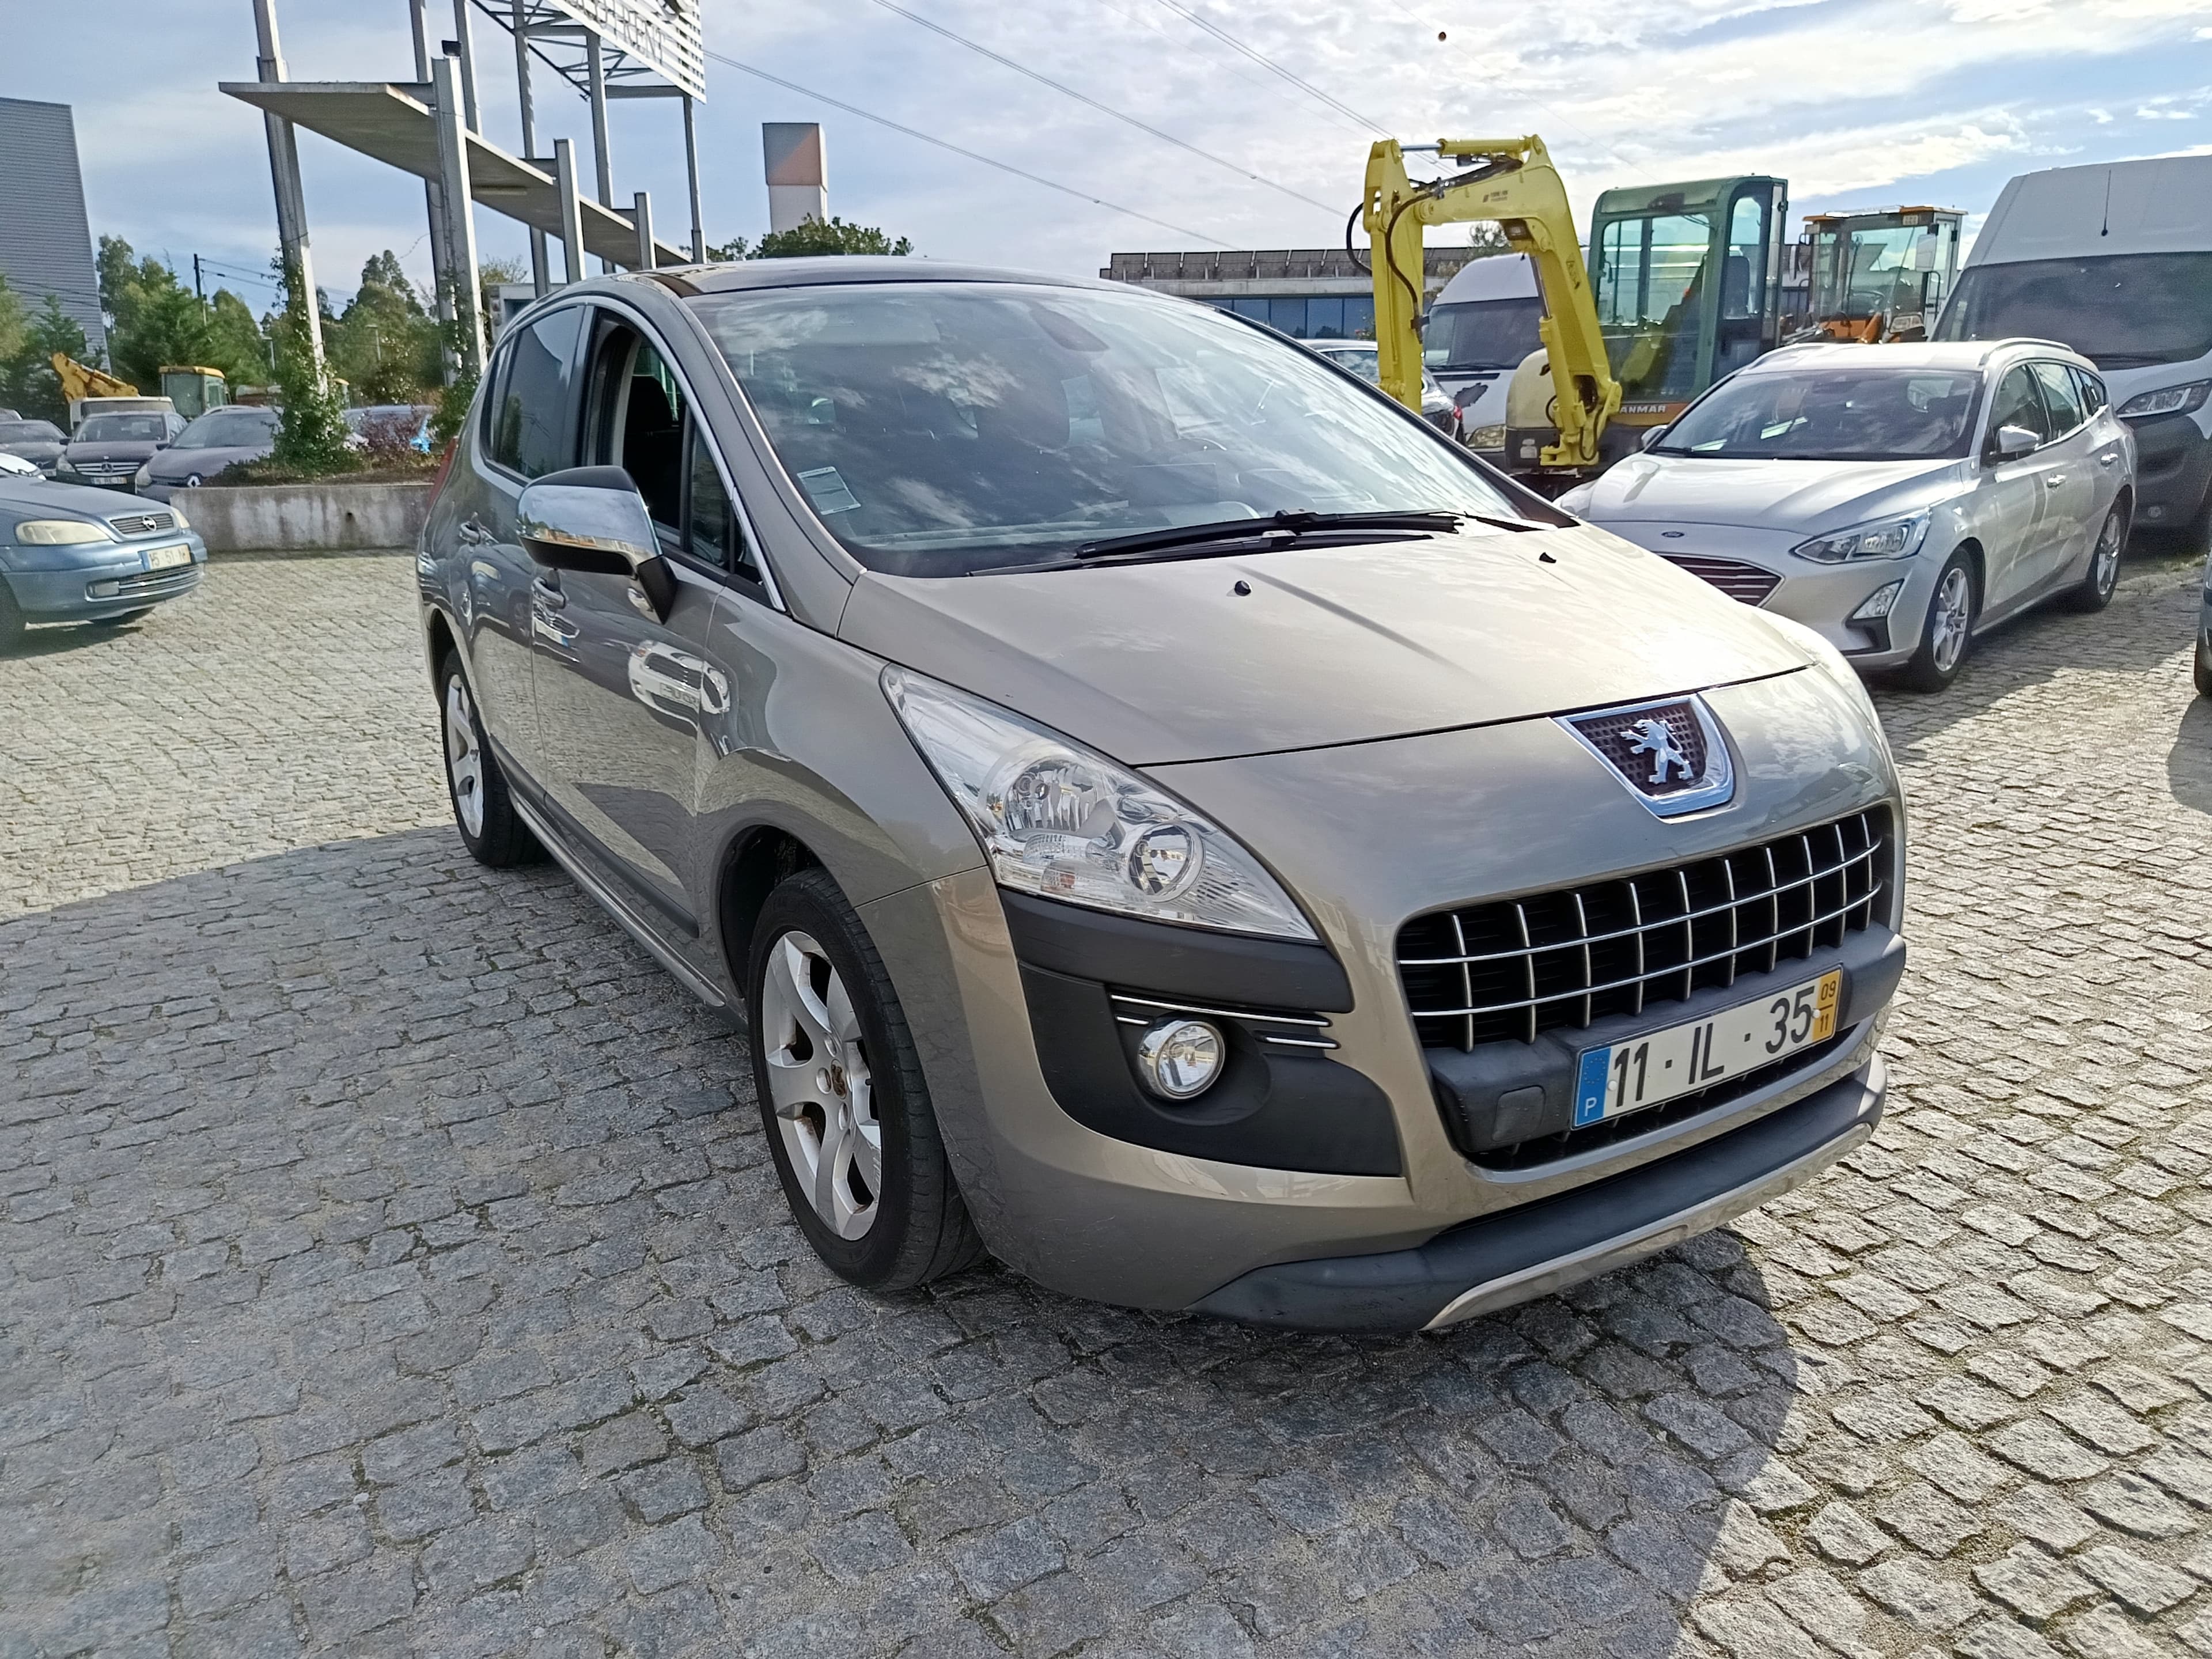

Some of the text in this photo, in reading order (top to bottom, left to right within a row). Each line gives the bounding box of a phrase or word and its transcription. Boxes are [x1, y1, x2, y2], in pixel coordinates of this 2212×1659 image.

[1619, 405, 1666, 414] ANMAR
[1821, 980, 1836, 1001] 09
[1820, 1014, 1829, 1032] 11
[1585, 1097, 1597, 1117] P
